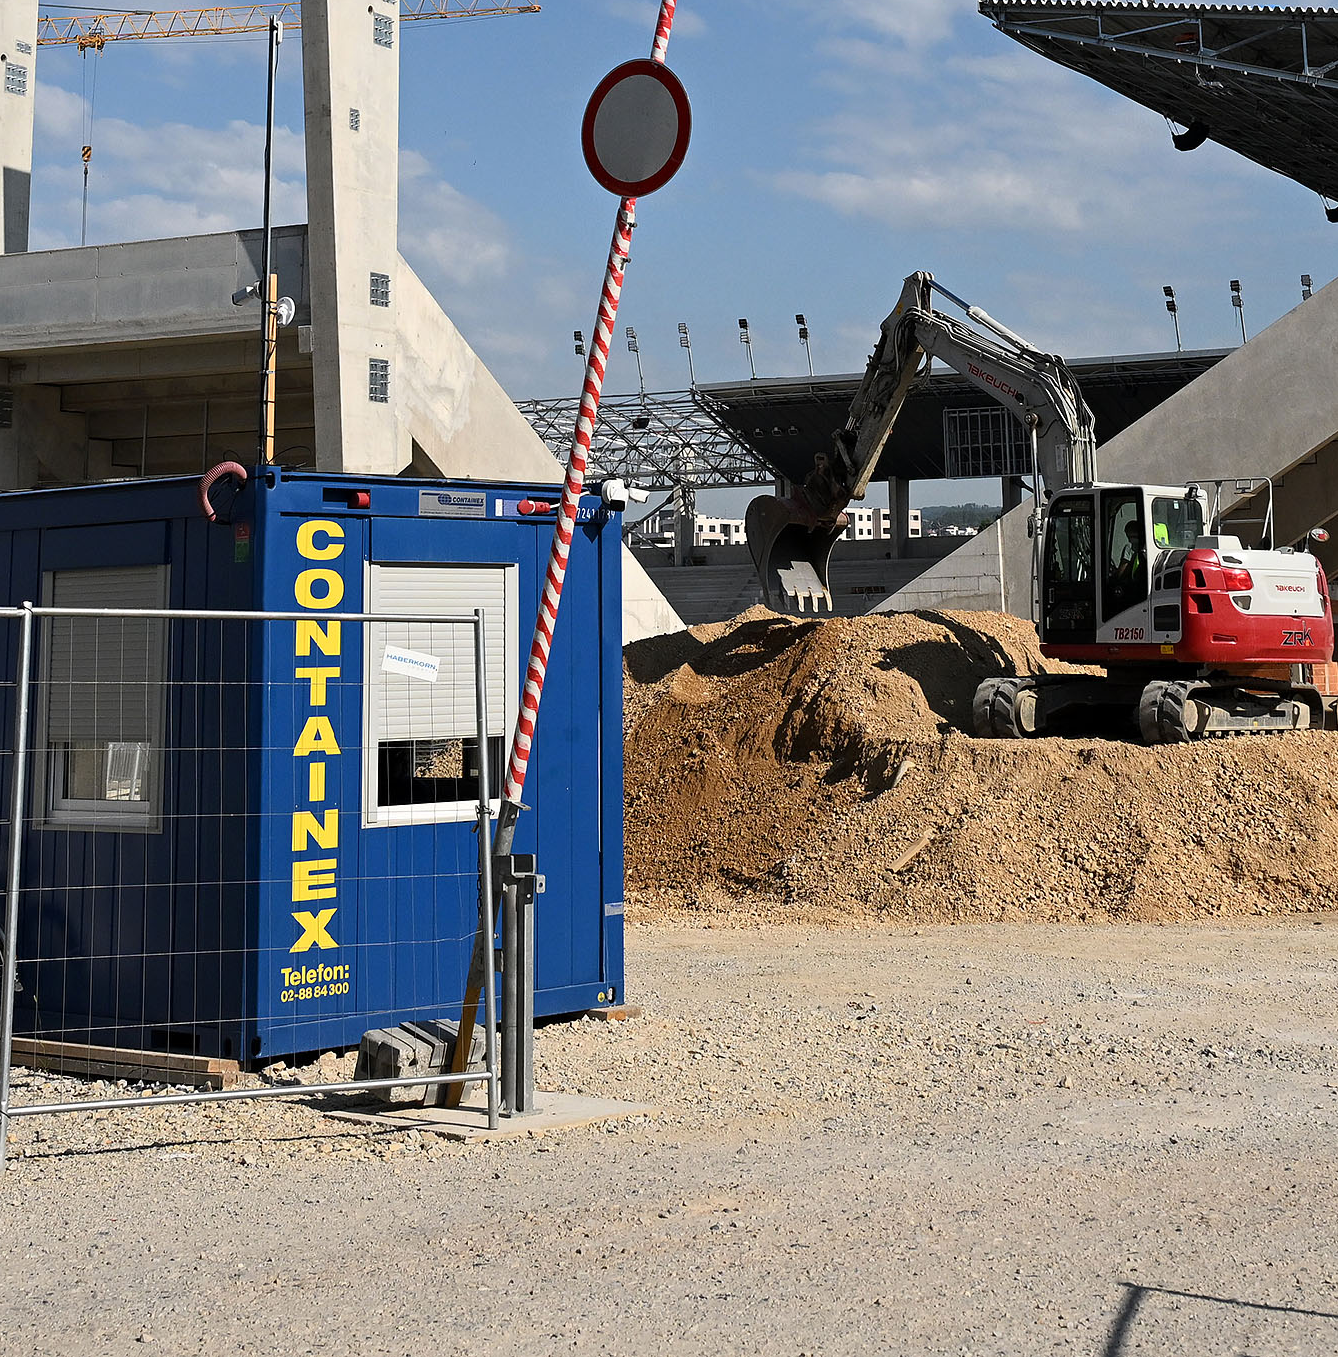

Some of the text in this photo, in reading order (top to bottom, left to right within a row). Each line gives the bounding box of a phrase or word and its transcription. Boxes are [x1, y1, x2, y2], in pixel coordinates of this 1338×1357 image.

[1114, 628, 1144, 640] TB2150
[1281, 622, 1315, 646] ZRK
[289, 520, 345, 953] CONTAINEX
[281, 963, 349, 987] Telefon:
